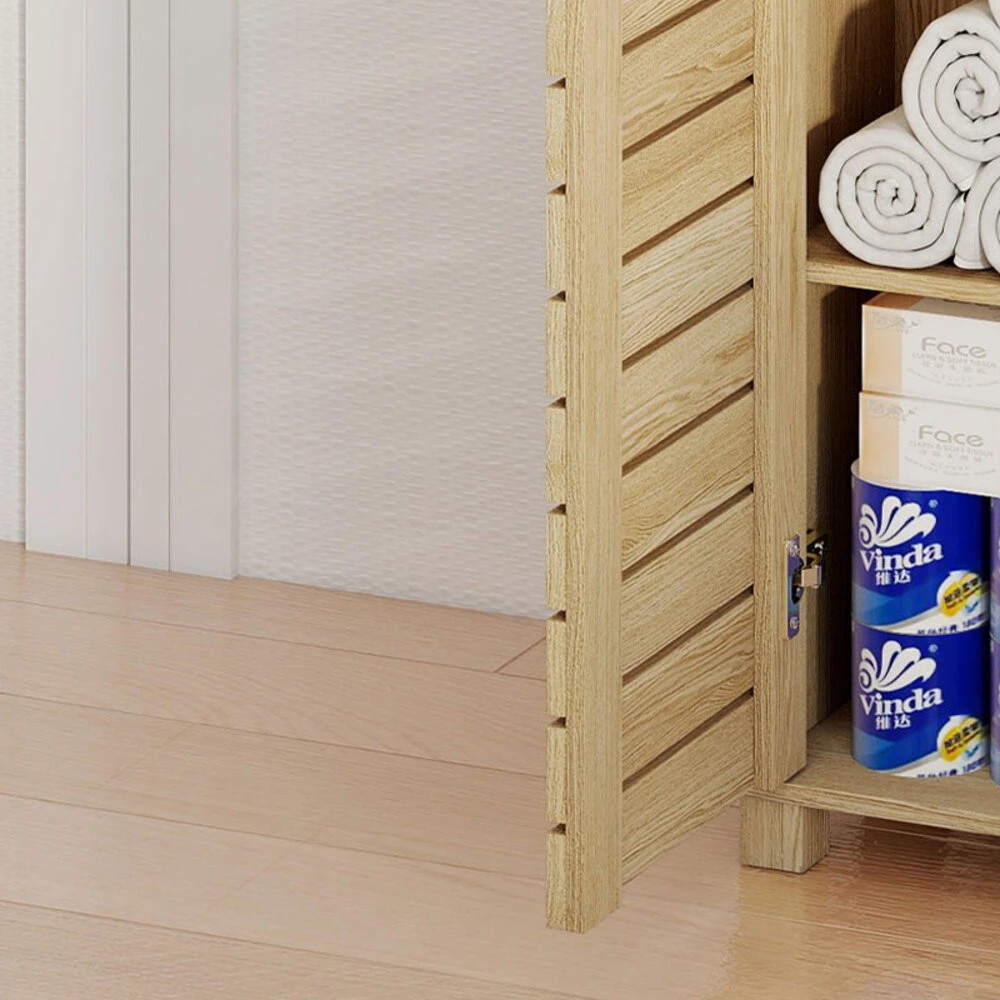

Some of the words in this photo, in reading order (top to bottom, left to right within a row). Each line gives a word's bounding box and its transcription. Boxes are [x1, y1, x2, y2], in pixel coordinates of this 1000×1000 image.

[921, 336, 987, 359] Face
[919, 424, 984, 447] Face
[860, 543, 944, 571] Vinda
[875, 569, 911, 586] 维达
[860, 687, 944, 716] Vinda
[875, 714, 911, 731] 维达
